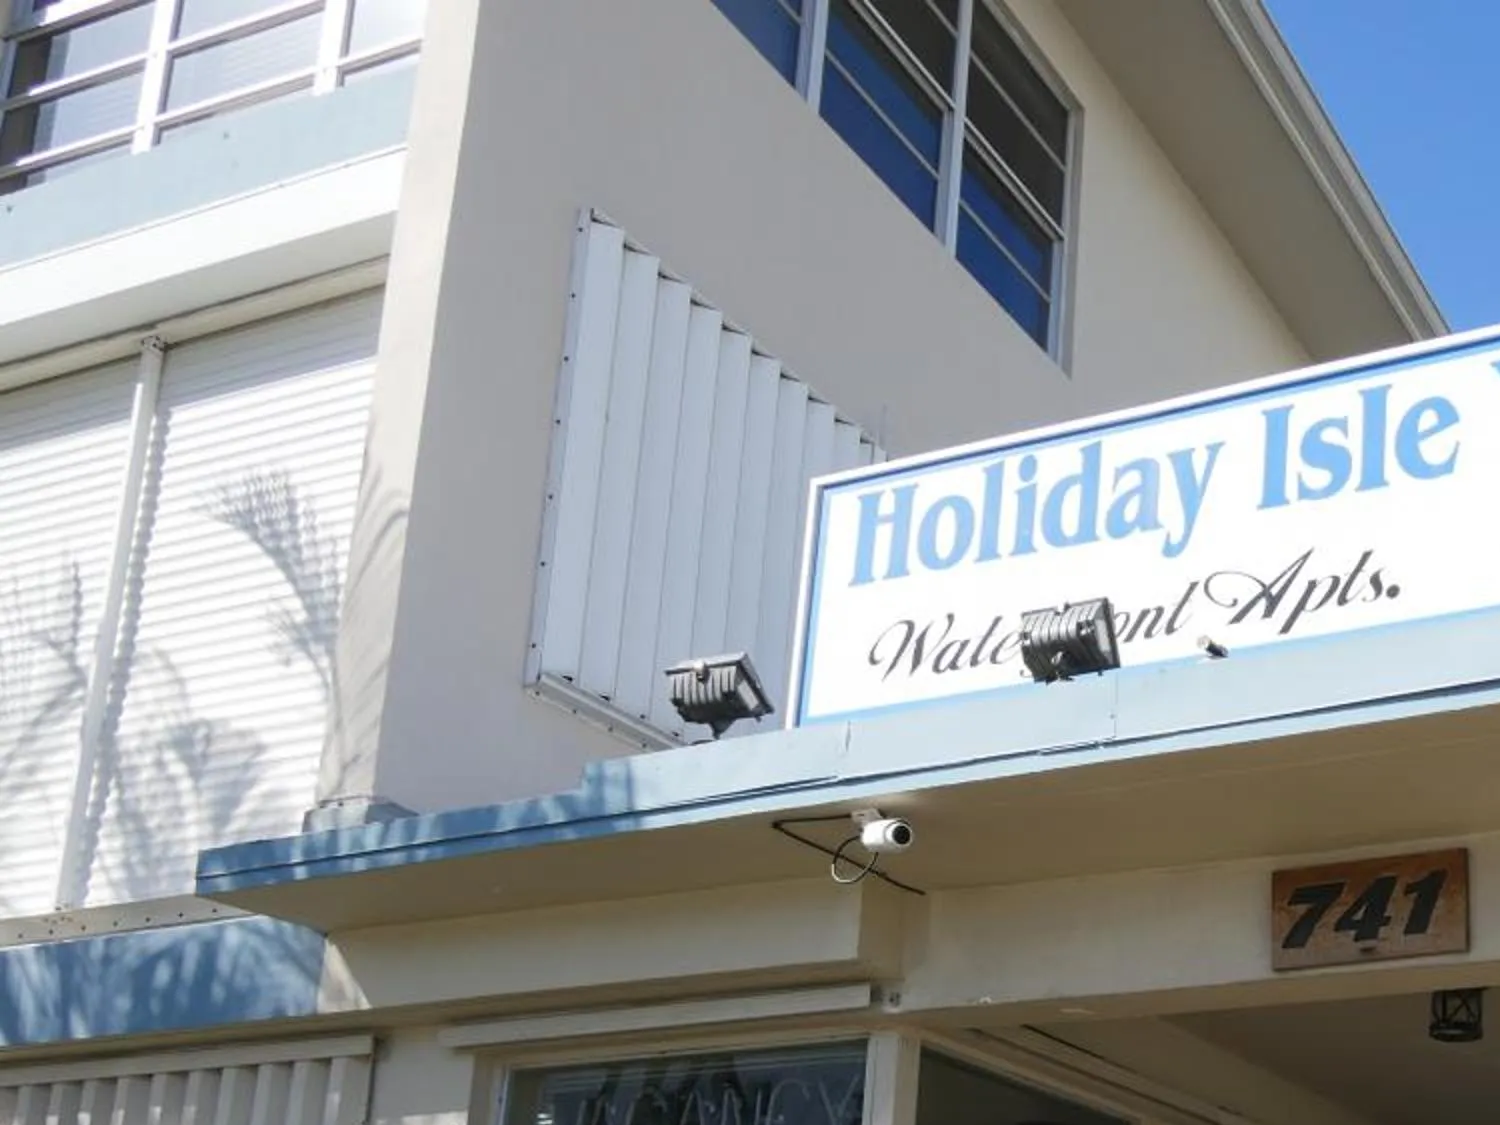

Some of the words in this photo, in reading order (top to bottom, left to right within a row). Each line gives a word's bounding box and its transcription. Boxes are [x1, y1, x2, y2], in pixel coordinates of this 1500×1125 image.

[848, 440, 1224, 558] Holiday
[1256, 383, 1459, 510] Isle
[1203, 547, 1401, 635] Apts.
[1281, 868, 1449, 949] 741
